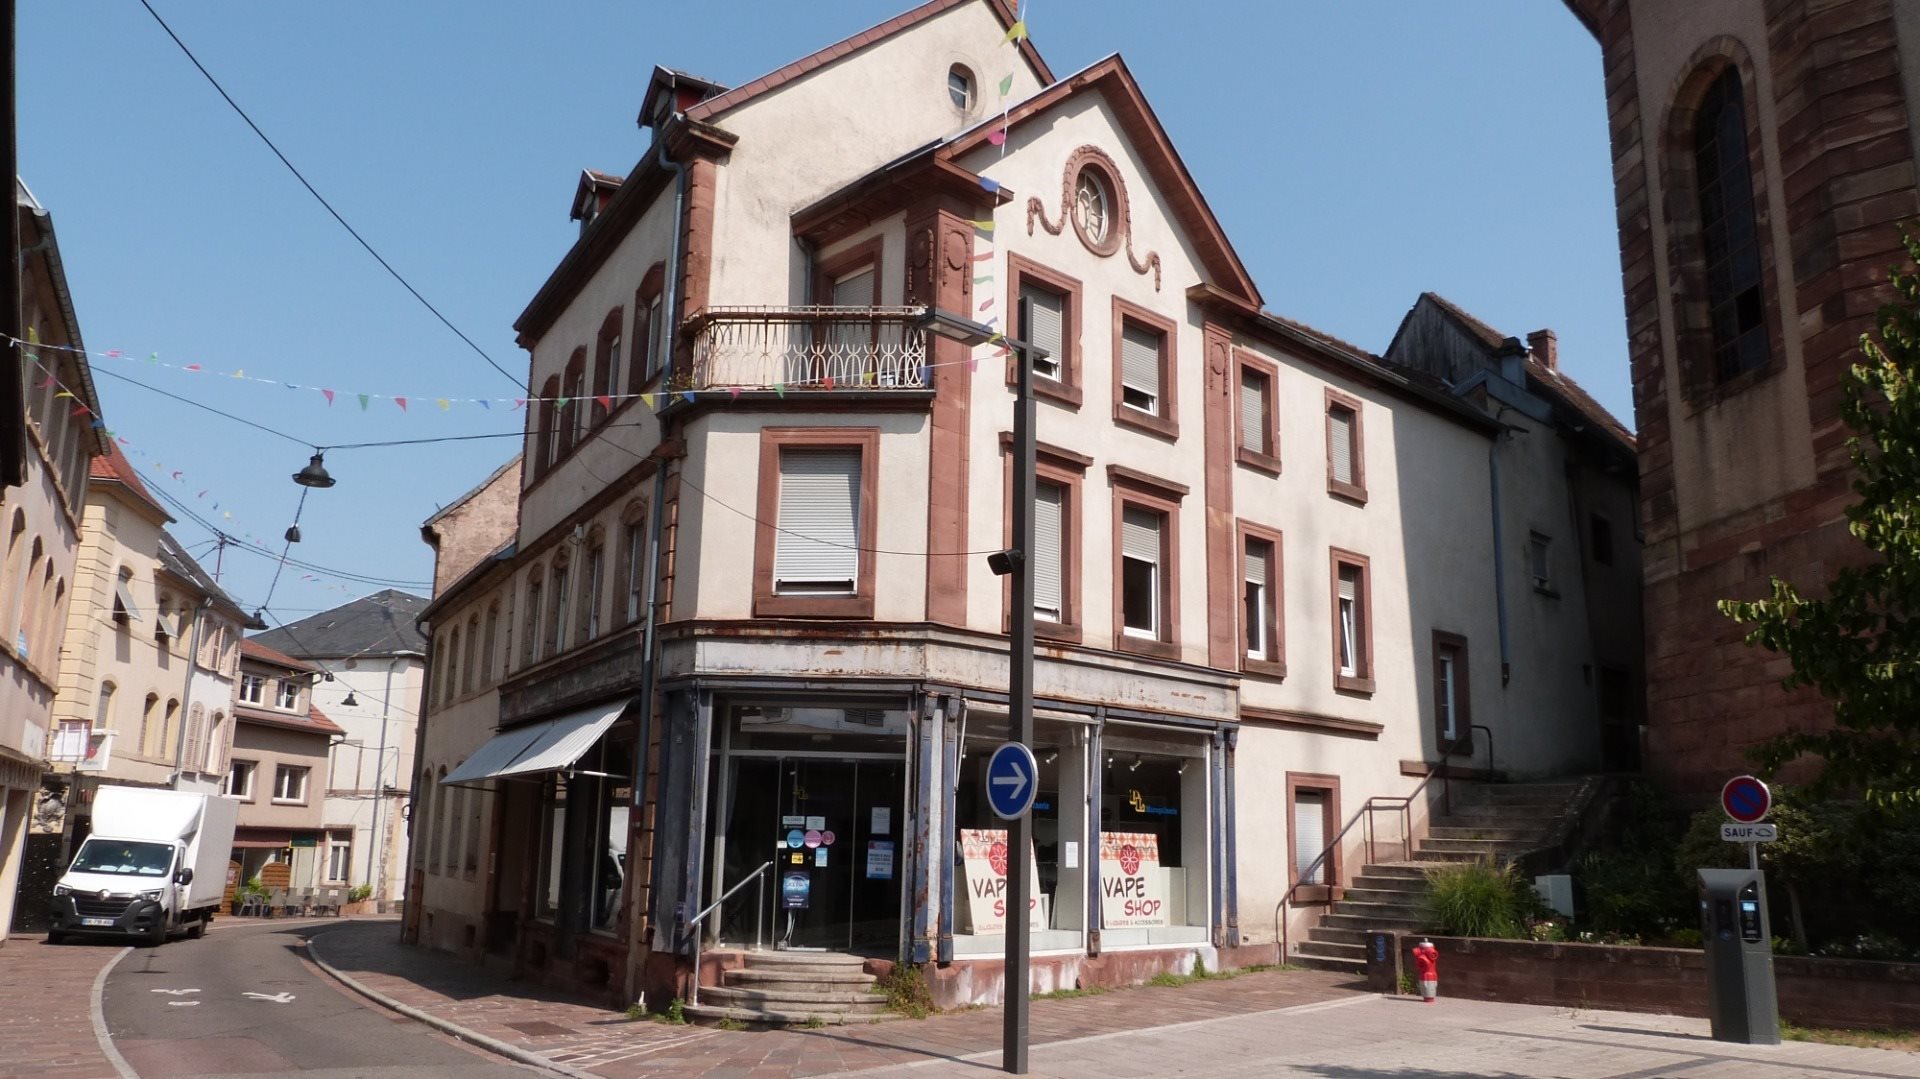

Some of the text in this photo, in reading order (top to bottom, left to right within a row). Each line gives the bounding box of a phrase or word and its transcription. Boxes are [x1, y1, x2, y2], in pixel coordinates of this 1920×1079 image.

[1724, 827, 1753, 838] SAUF
[972, 877, 1008, 899] VAP
[1103, 876, 1146, 899] VAPE
[1124, 899, 1162, 917] SHOP
